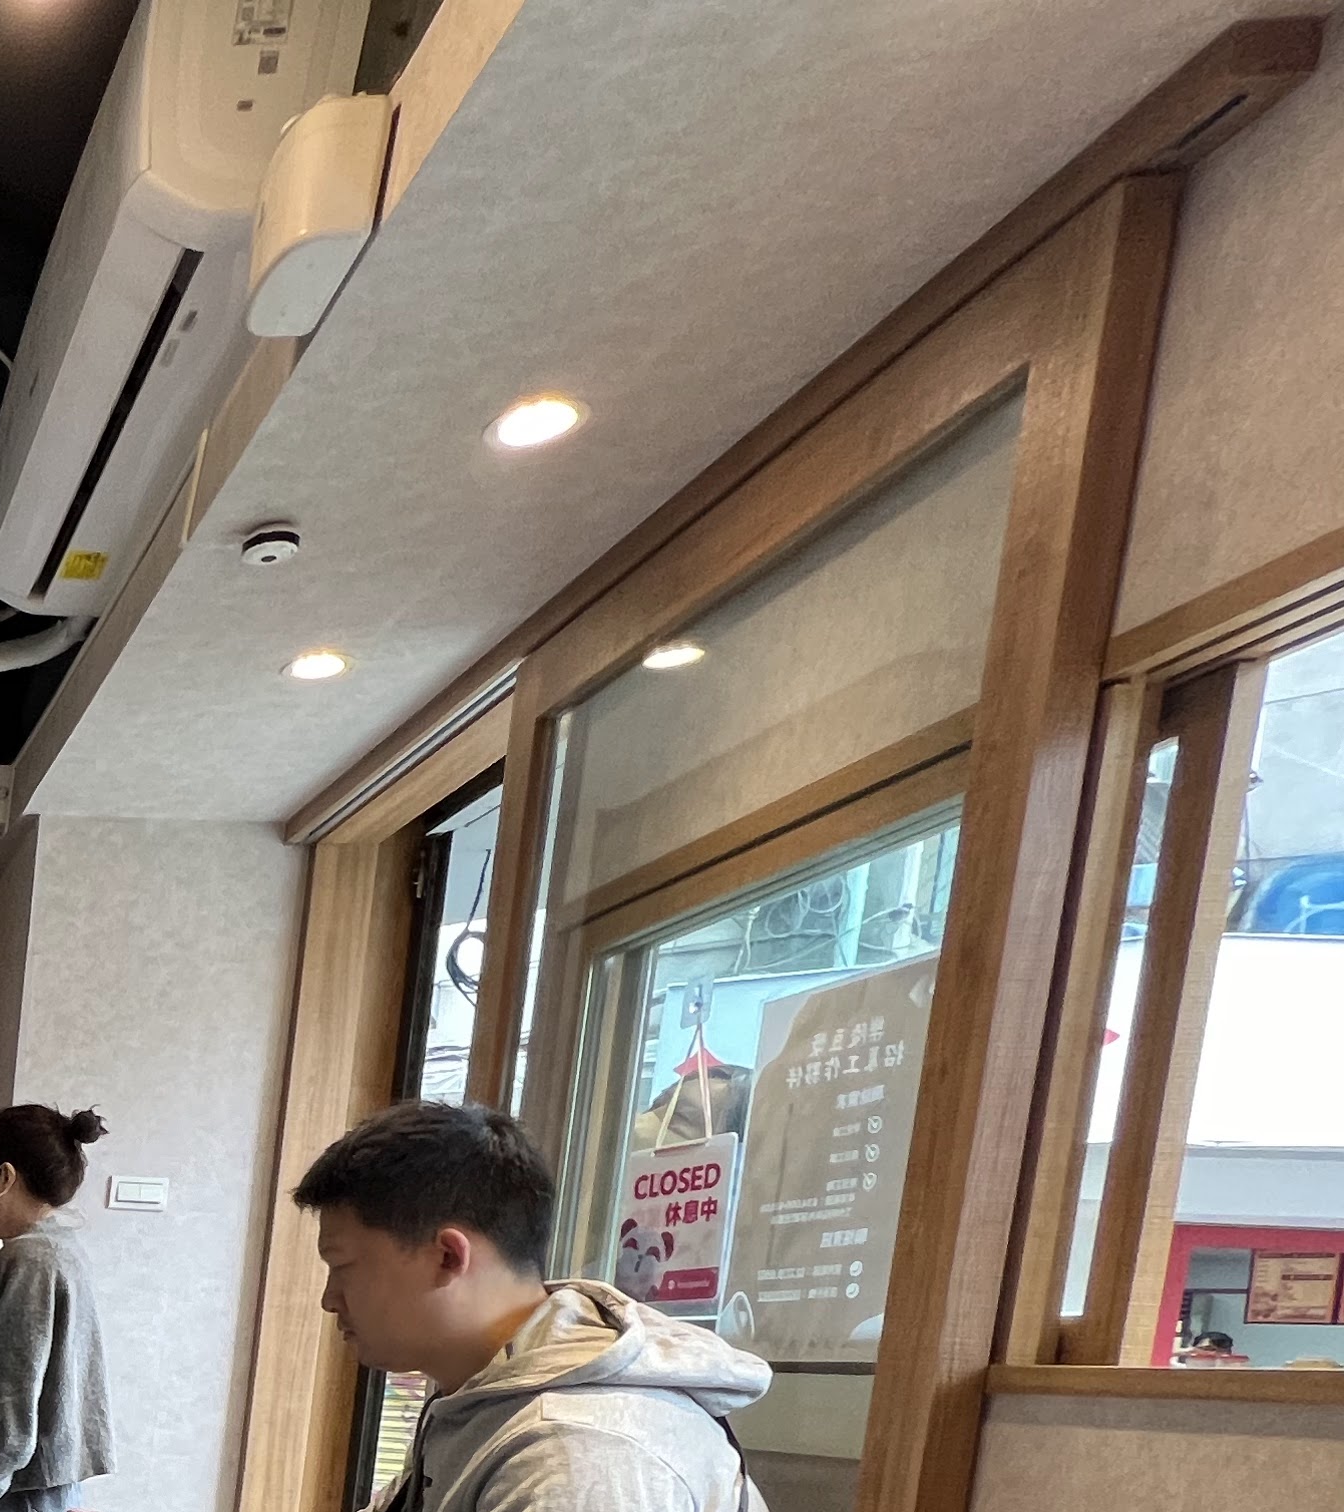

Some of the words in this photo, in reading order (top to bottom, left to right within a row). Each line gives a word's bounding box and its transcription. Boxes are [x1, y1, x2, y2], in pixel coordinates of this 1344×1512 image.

[634, 1163, 721, 1200] CLOSED
[665, 1196, 718, 1227] 休息中
